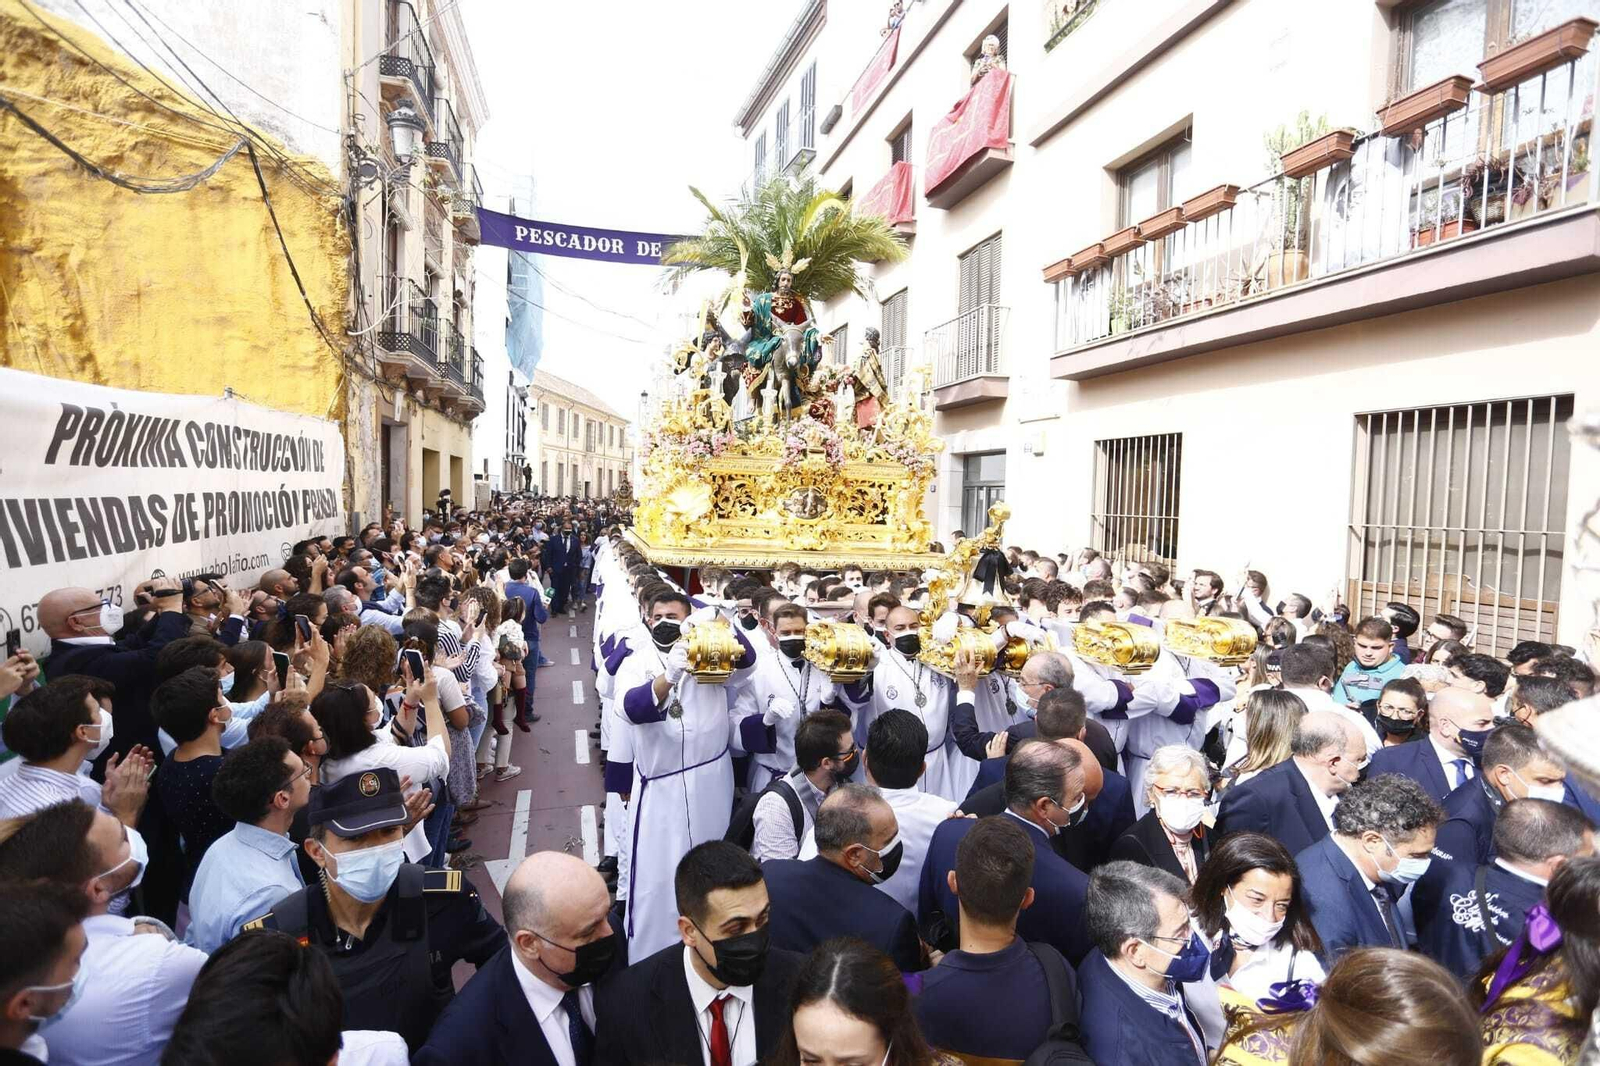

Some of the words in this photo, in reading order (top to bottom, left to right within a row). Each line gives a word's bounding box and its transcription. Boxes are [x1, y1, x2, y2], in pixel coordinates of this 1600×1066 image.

[514, 225, 625, 254] PESCADOR
[637, 240, 662, 257] DE
[185, 420, 311, 472] CONSTRUCCIÓN
[312, 439, 325, 473] DE
[0, 493, 168, 569] IVIENDAS
[171, 493, 201, 544] DE
[202, 483, 300, 539] PROMOCIÓN
